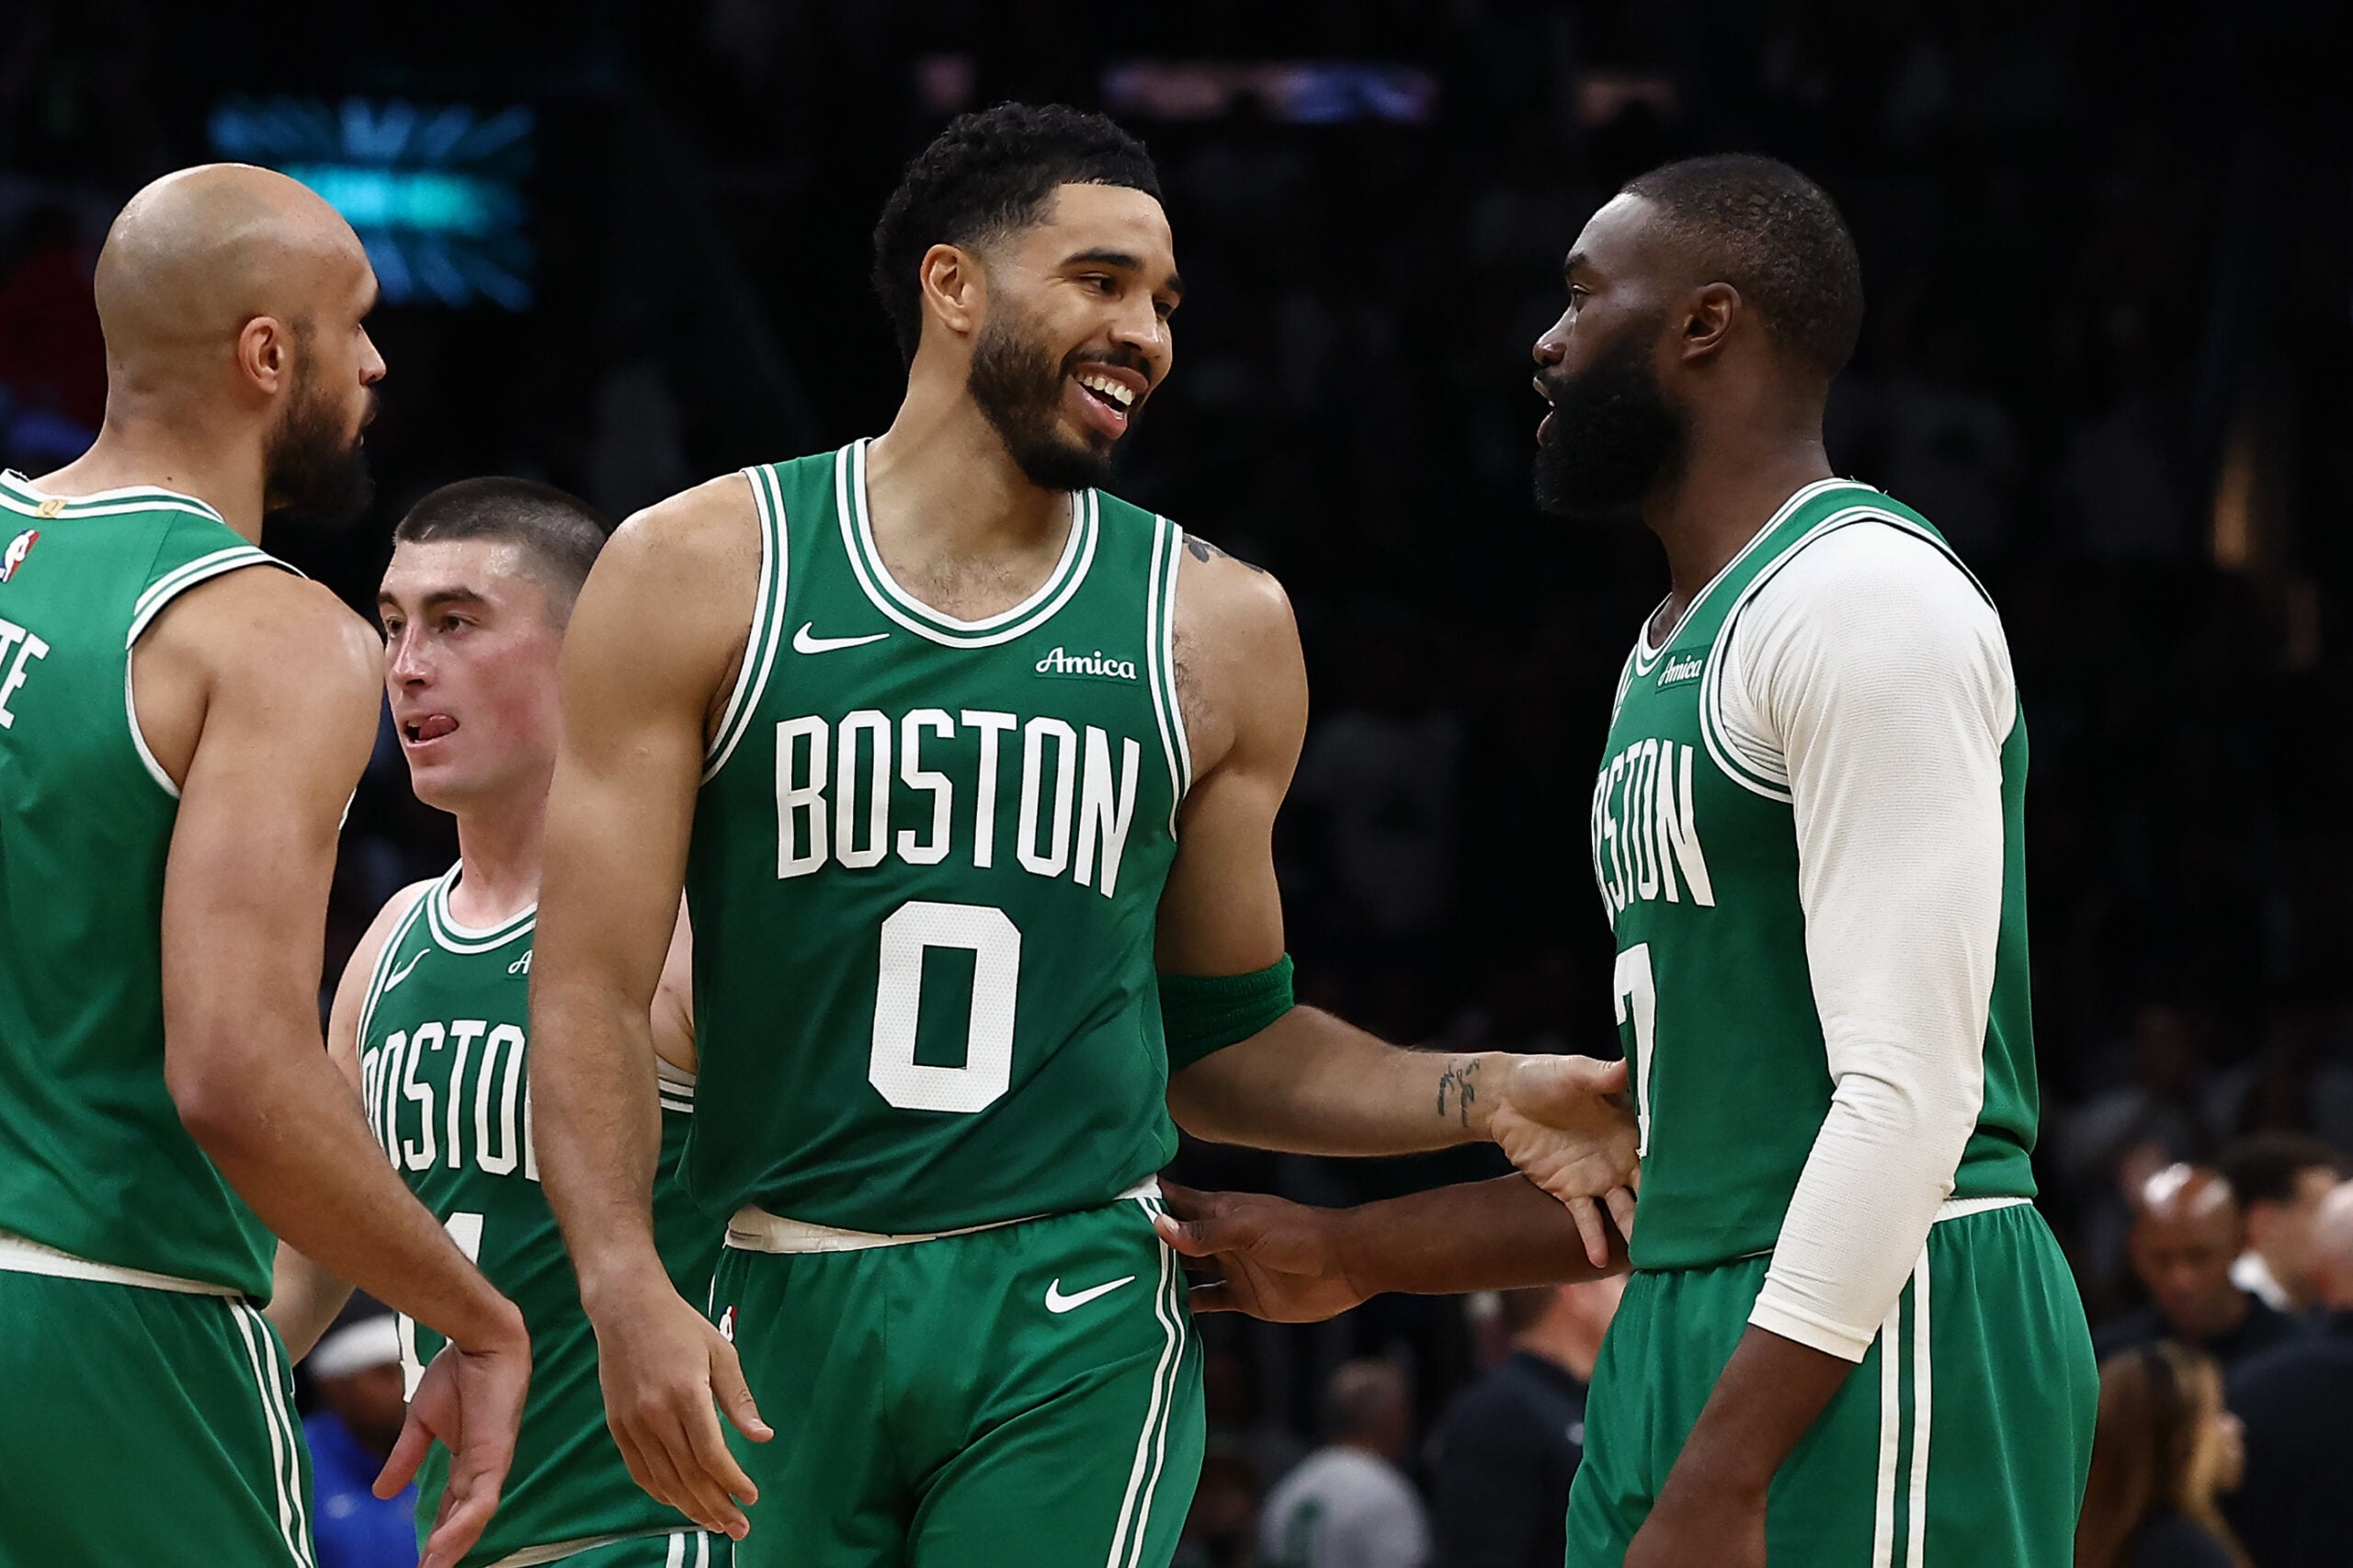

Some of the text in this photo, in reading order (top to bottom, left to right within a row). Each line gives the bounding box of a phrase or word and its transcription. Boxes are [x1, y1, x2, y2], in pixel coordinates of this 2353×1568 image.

[1035, 646, 1137, 679] Amica
[1657, 654, 1703, 687] Amica
[776, 709, 1141, 898] BOSTON
[1591, 738, 1715, 932] OSTON
[868, 901, 1021, 1113] 0
[1613, 942, 1656, 1159] 7
